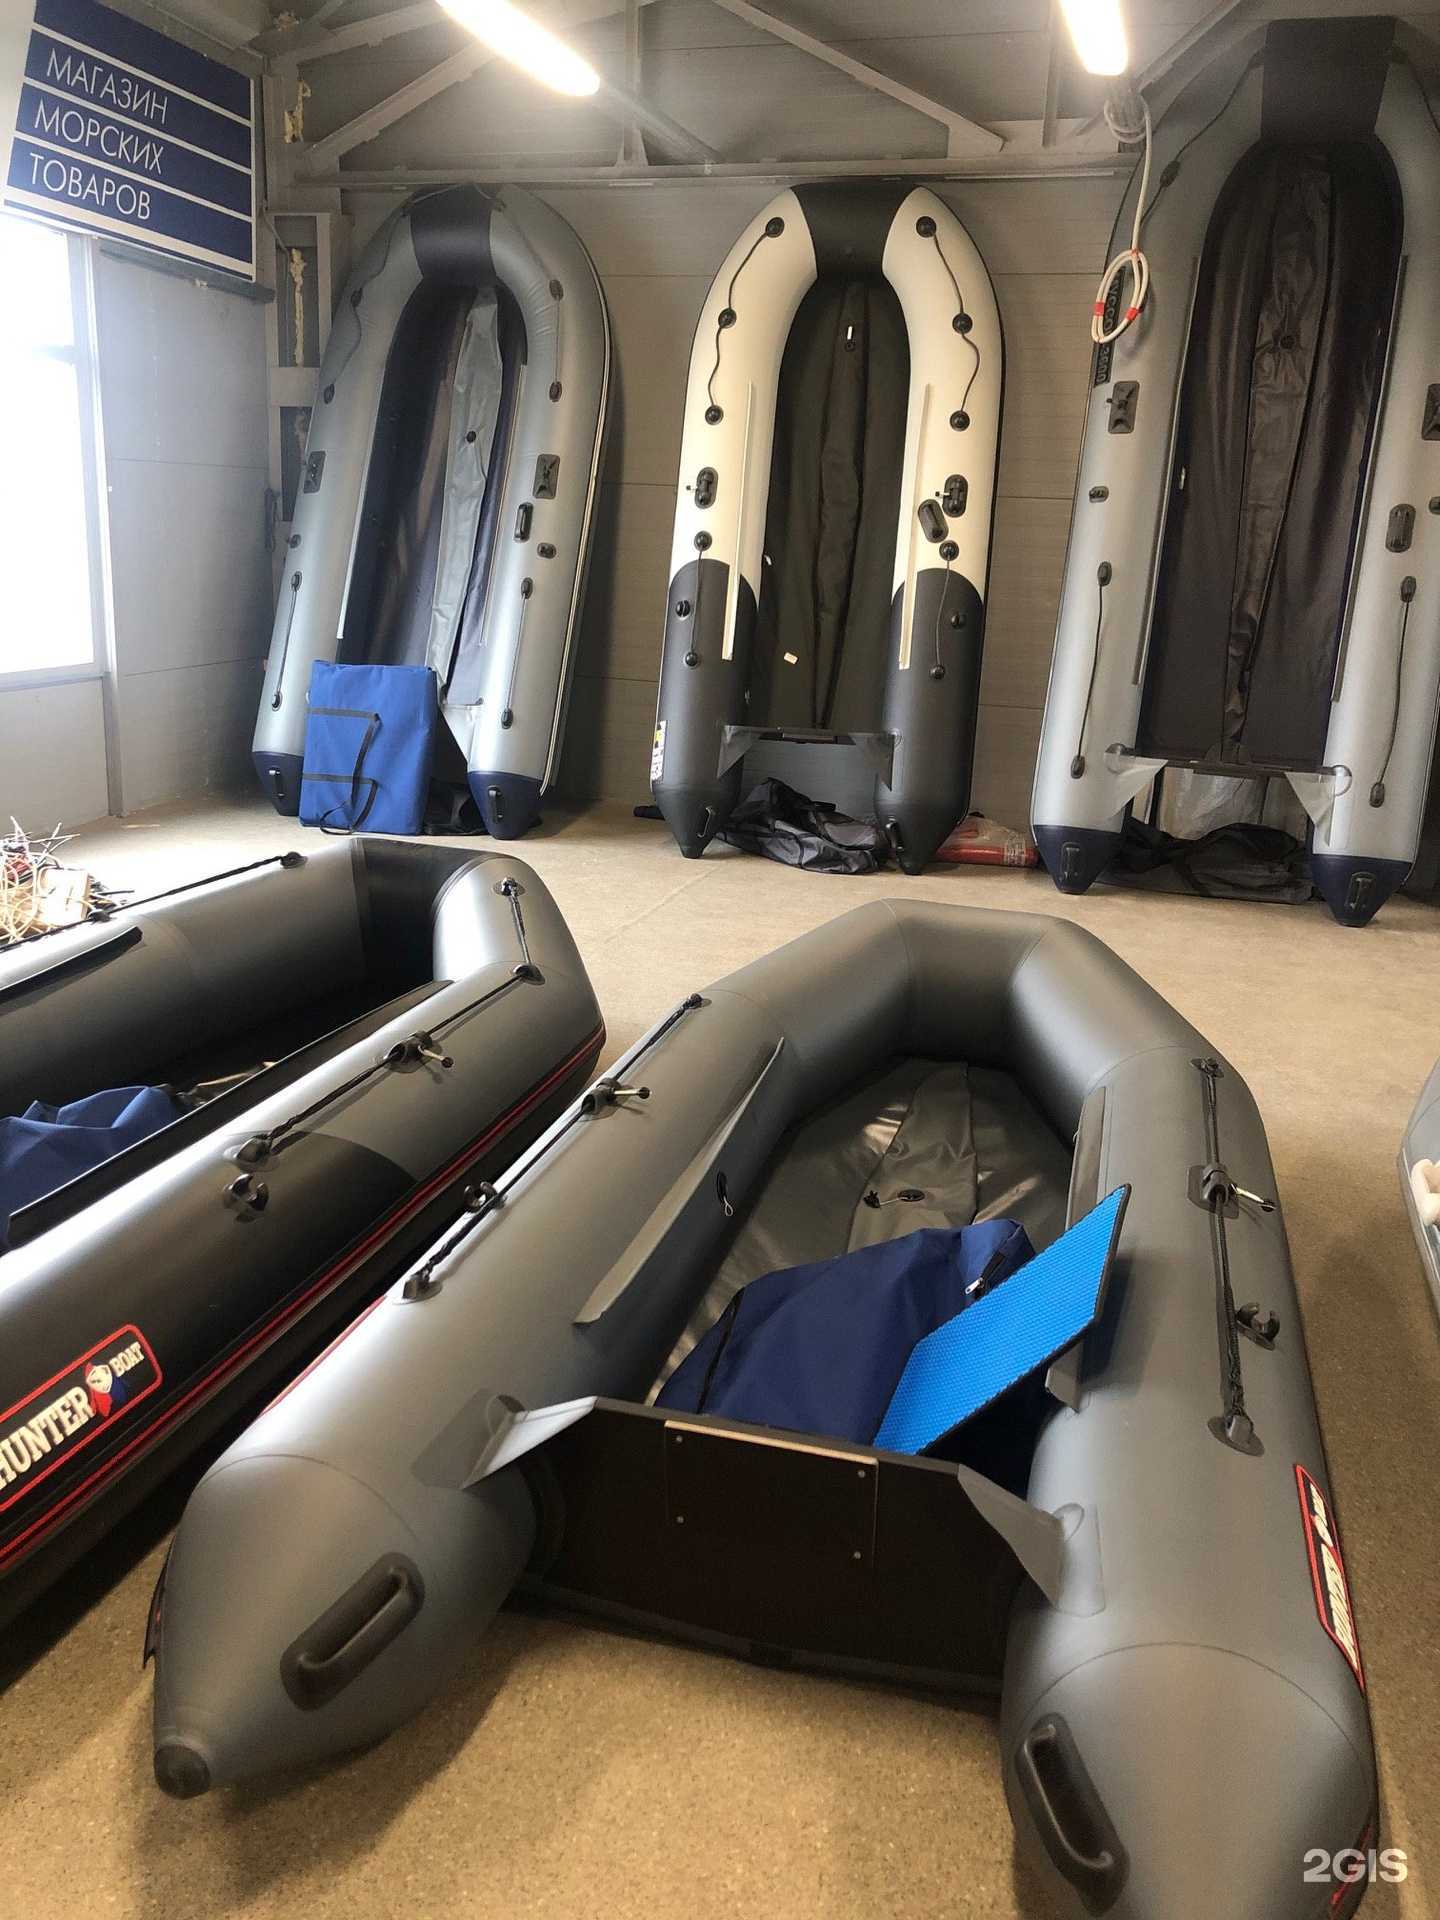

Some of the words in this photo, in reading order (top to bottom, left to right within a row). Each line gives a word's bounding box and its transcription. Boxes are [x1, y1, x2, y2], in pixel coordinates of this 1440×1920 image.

[47, 48, 168, 124] МАГАЗИН
[35, 101, 164, 175] МОРСКИХ
[30, 152, 150, 220] ТОВАРОВ
[0, 1386, 96, 1490] HUNTER
[109, 1342, 144, 1377] BOAT
